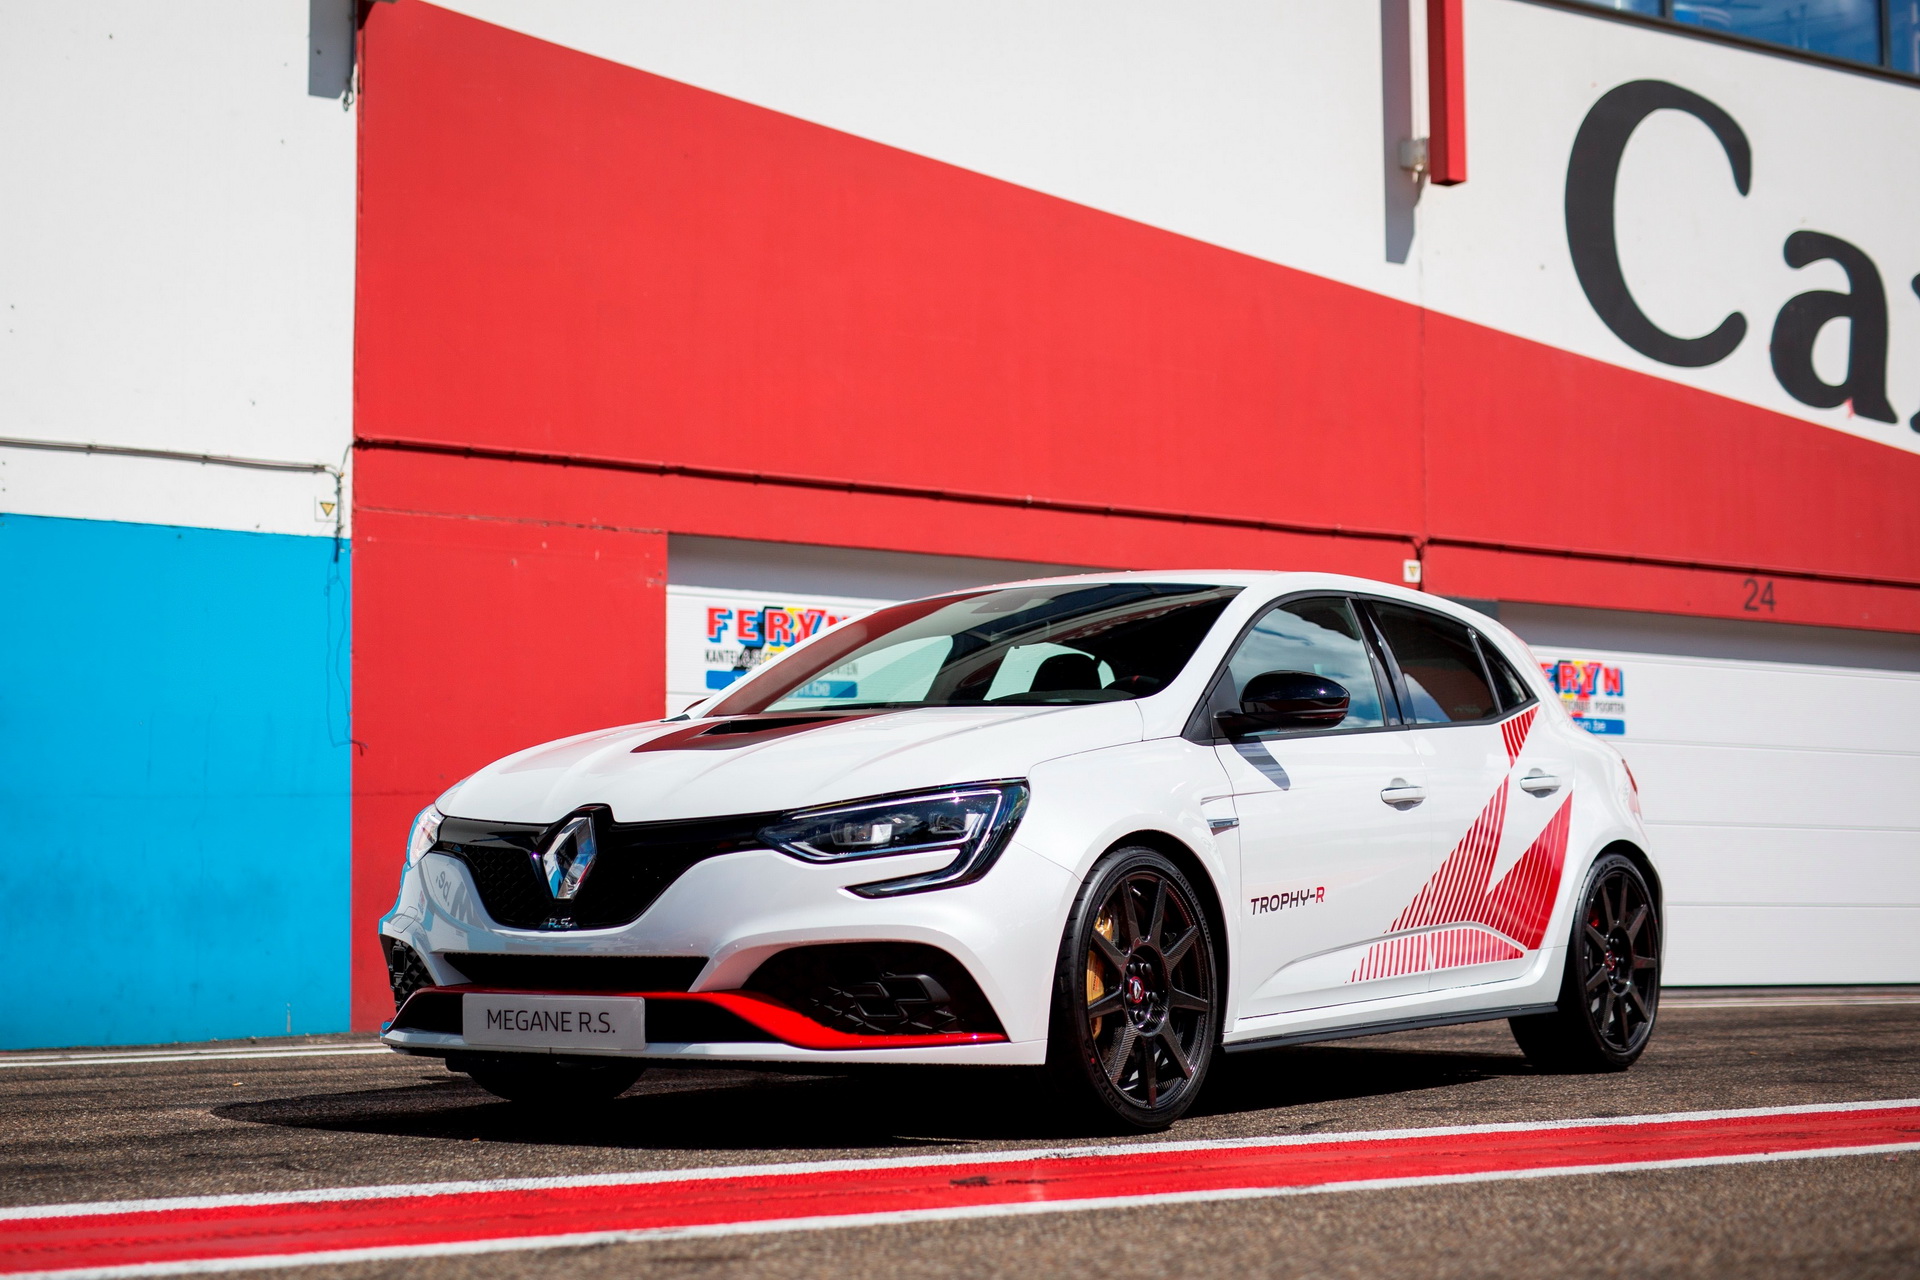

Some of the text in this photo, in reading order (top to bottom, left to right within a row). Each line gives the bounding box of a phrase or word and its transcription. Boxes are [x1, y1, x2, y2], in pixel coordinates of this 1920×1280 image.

[1565, 79, 1920, 434] Ca
[1743, 578, 1776, 612] 24
[1250, 886, 1325, 916] TROPHY-R
[487, 1009, 616, 1034] MEGANE R.S.
